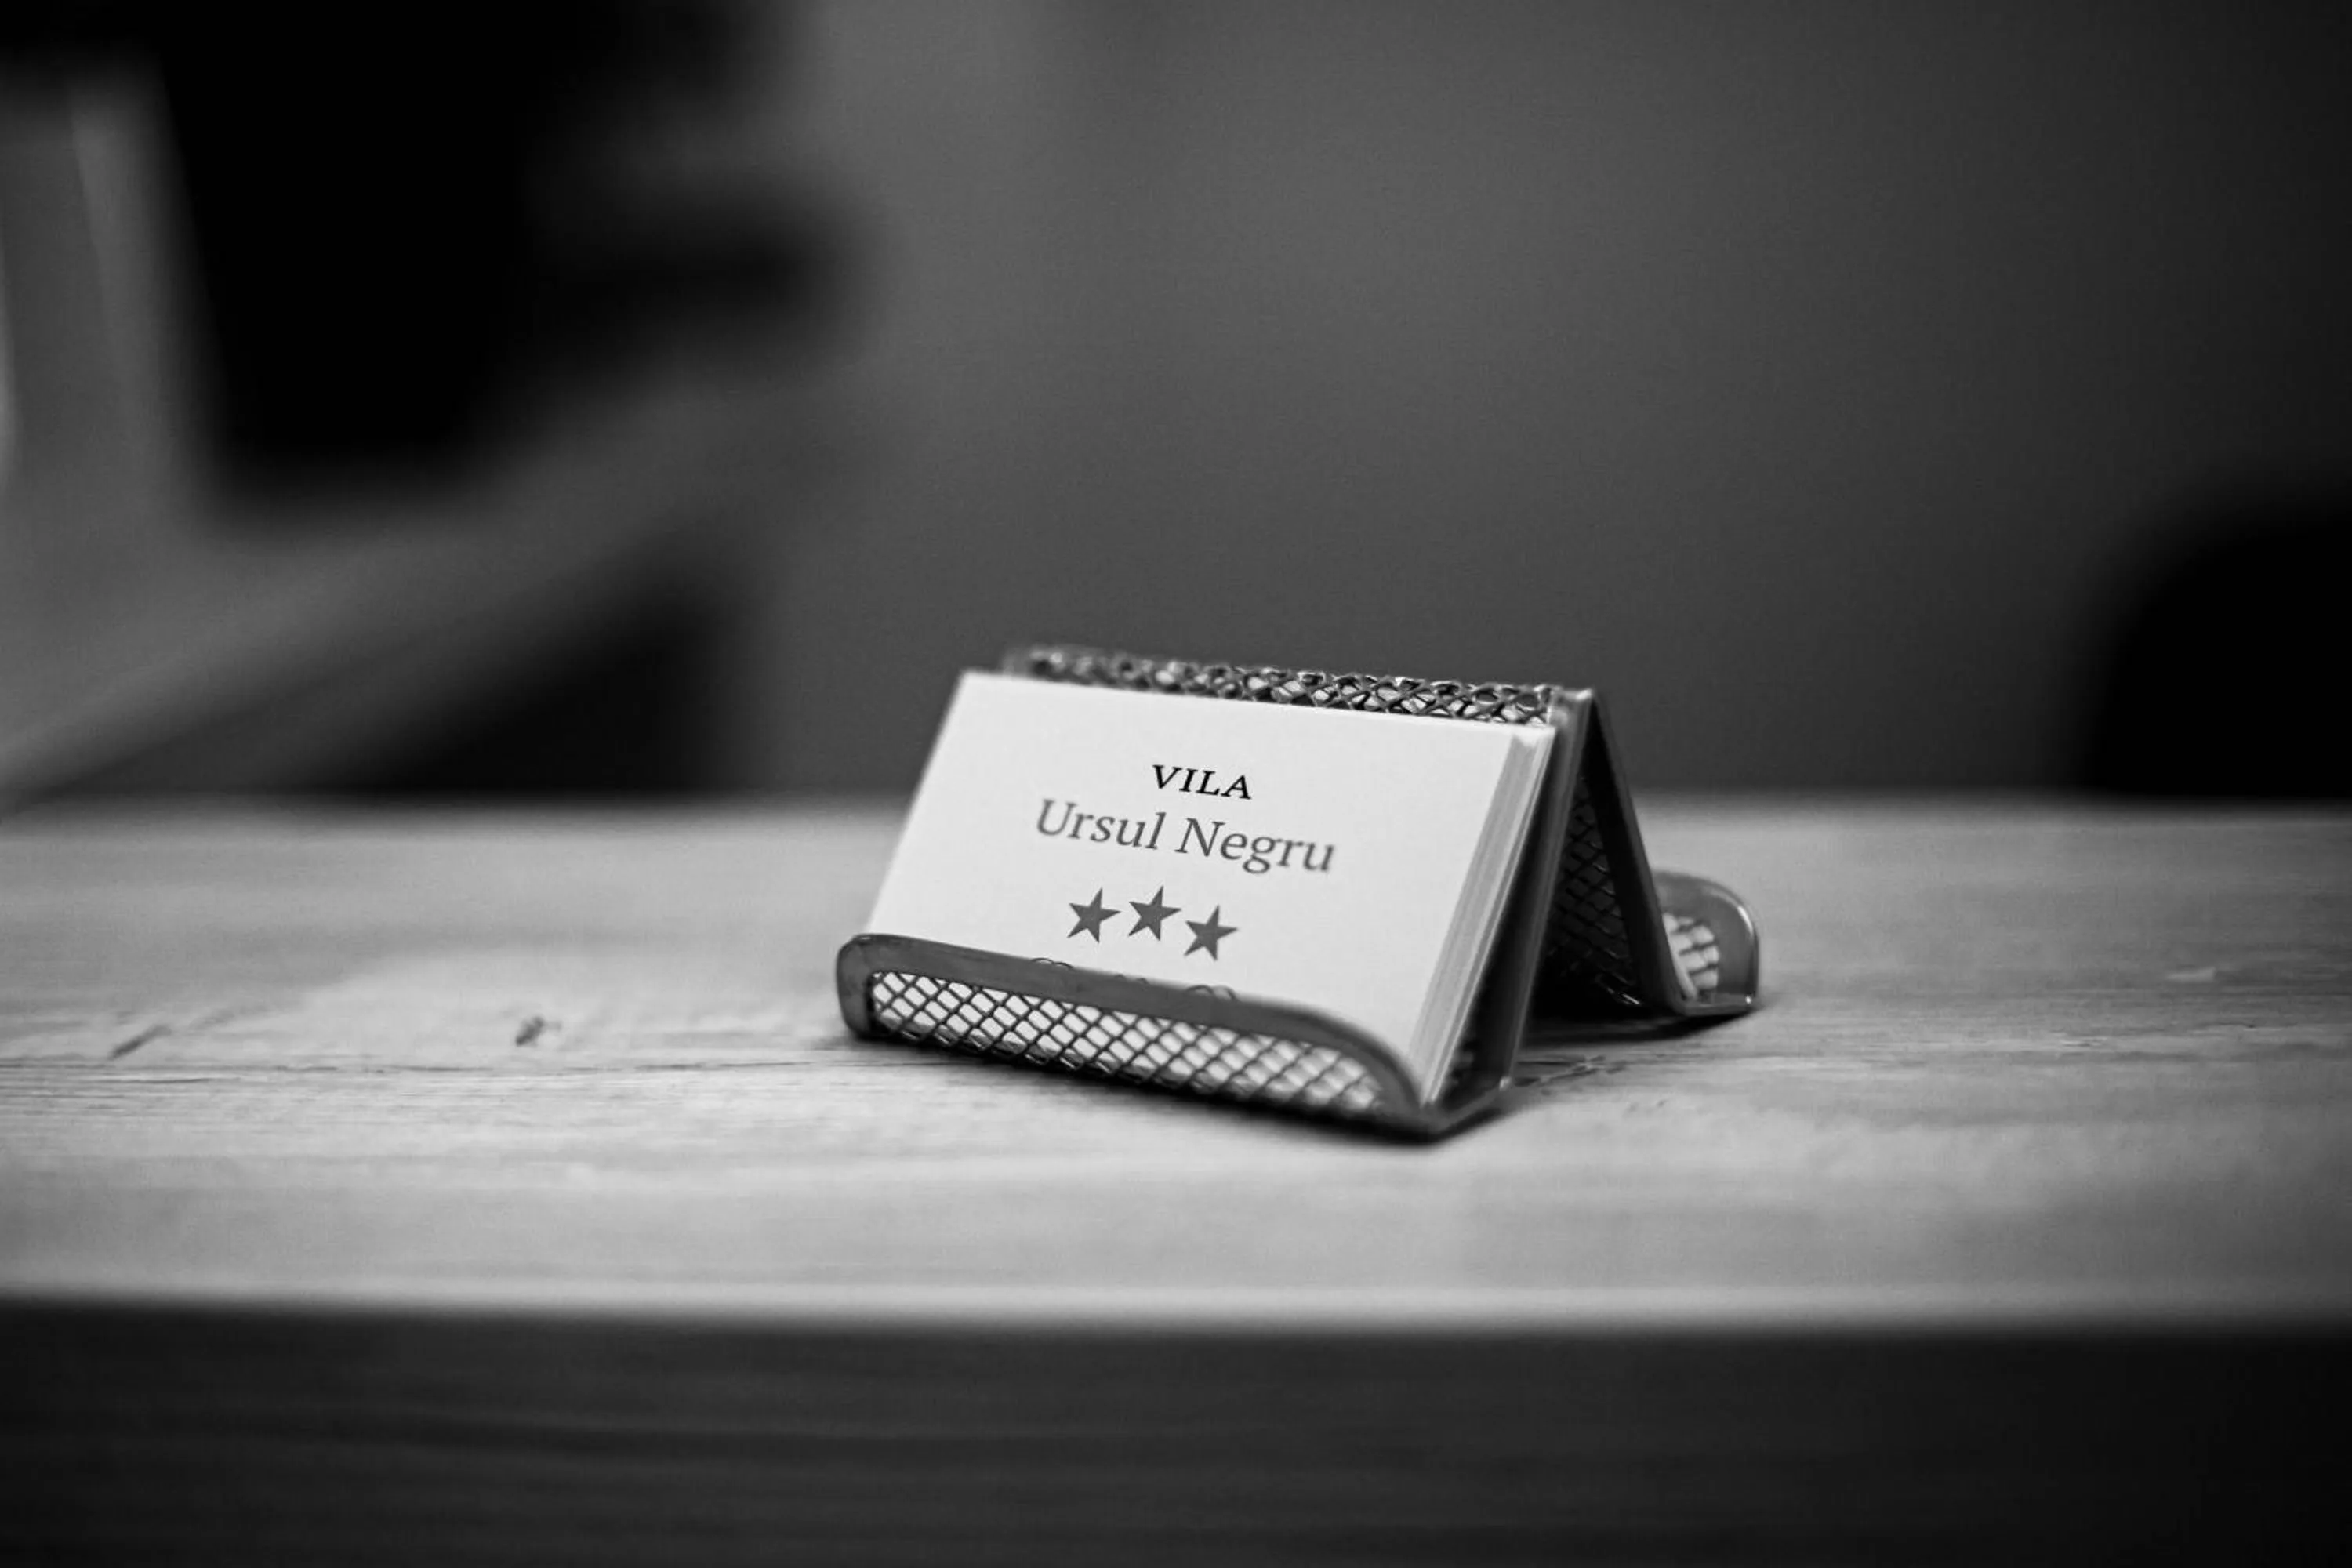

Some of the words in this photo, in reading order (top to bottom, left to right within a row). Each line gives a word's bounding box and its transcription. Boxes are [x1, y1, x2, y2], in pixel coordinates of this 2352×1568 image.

[1152, 764, 1252, 800] VILA
[1036, 799, 1167, 851] Ursul
[1174, 817, 1334, 874] Negru
